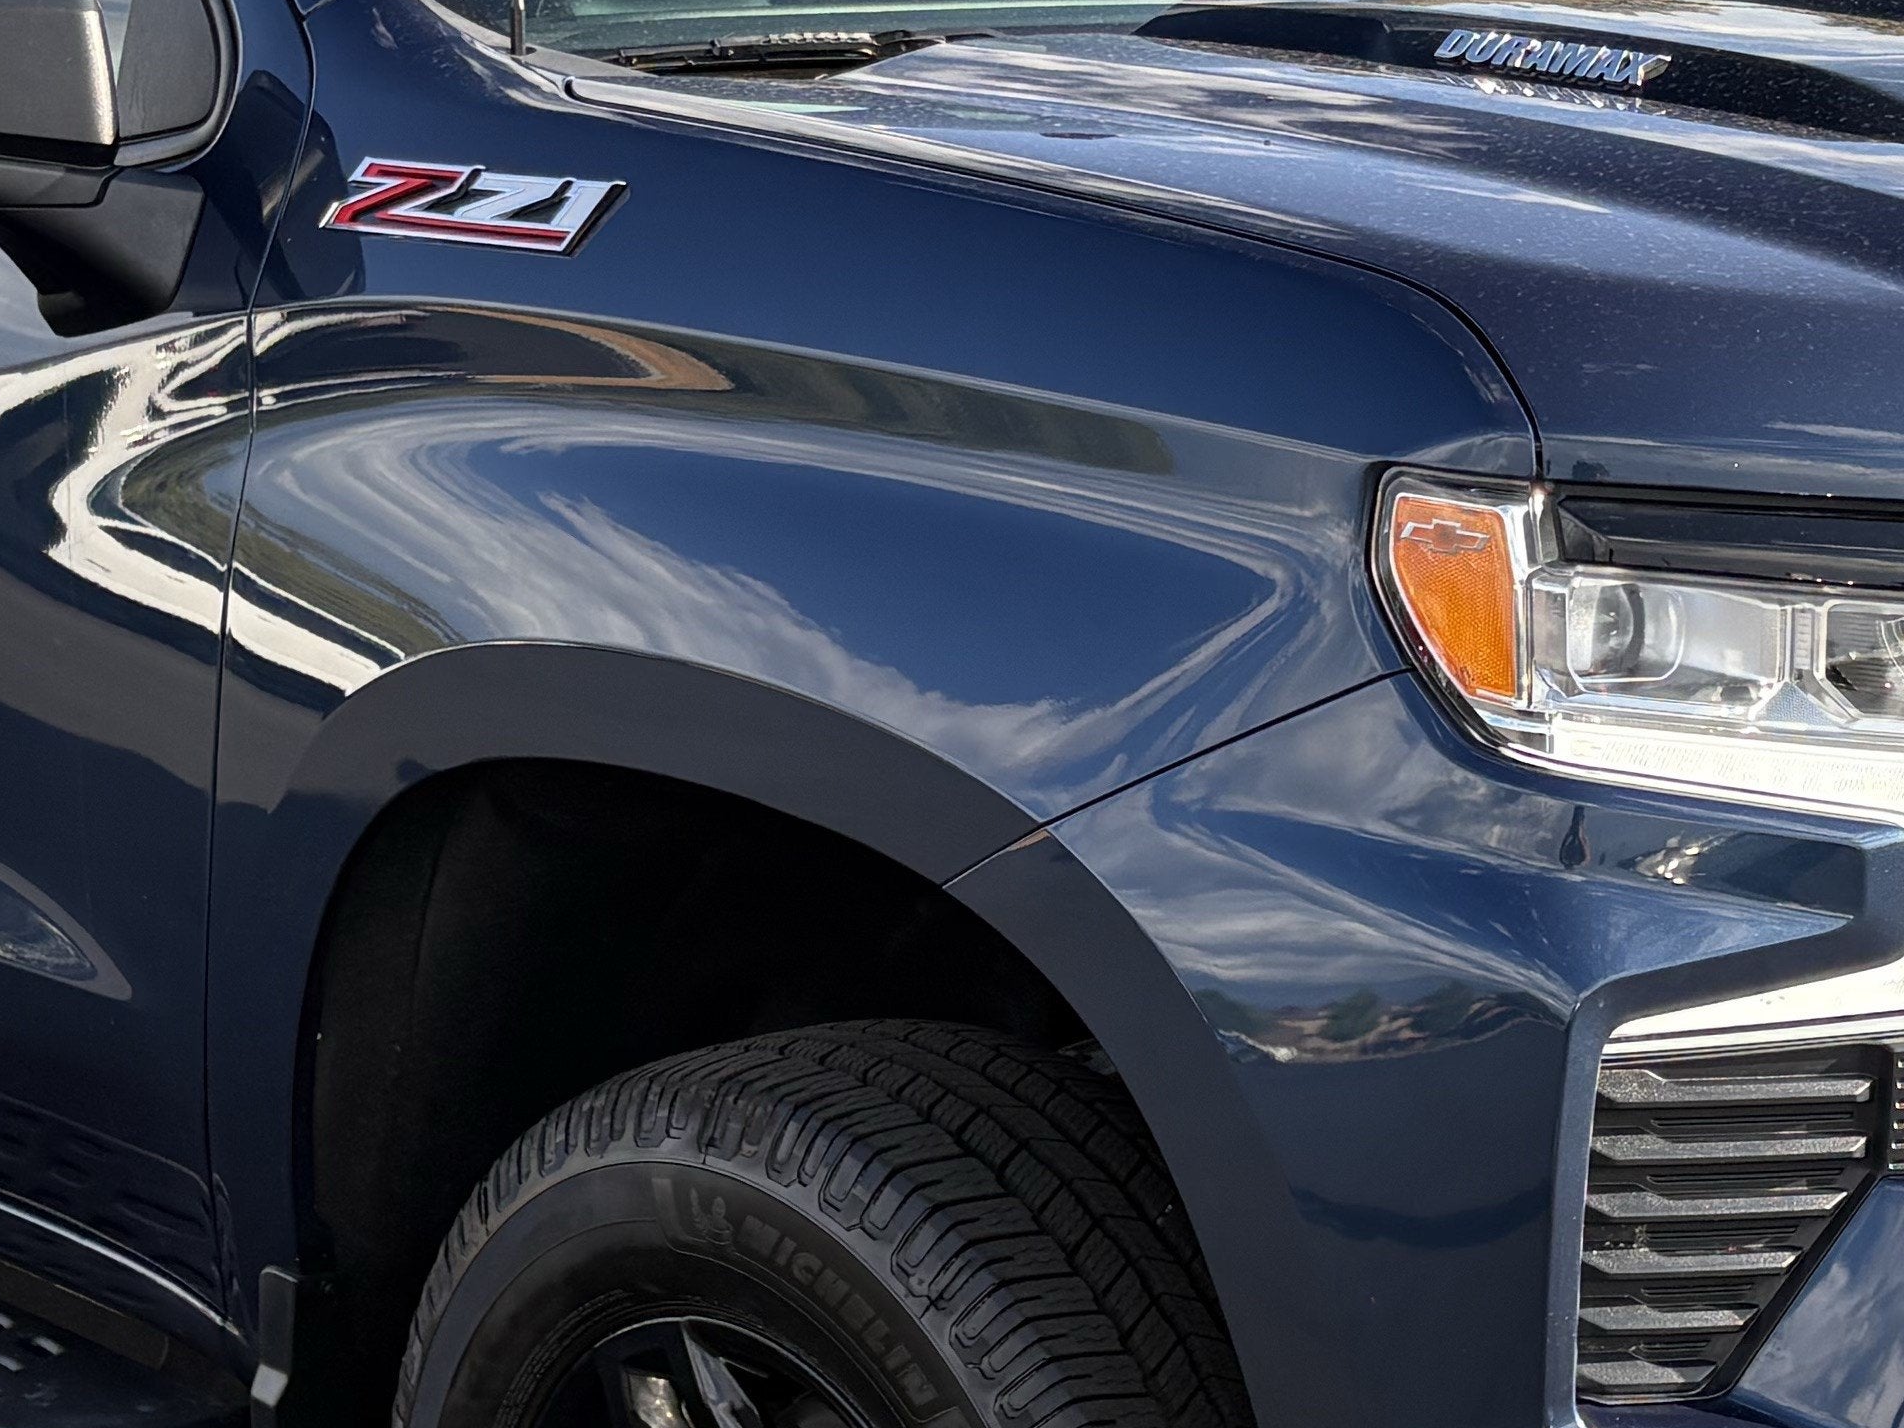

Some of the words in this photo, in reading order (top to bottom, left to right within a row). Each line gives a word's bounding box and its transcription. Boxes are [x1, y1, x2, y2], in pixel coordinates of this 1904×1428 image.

[1433, 28, 1672, 86] DURAMAX
[318, 156, 628, 254] Z71
[736, 1214, 939, 1407] MICHELIN
